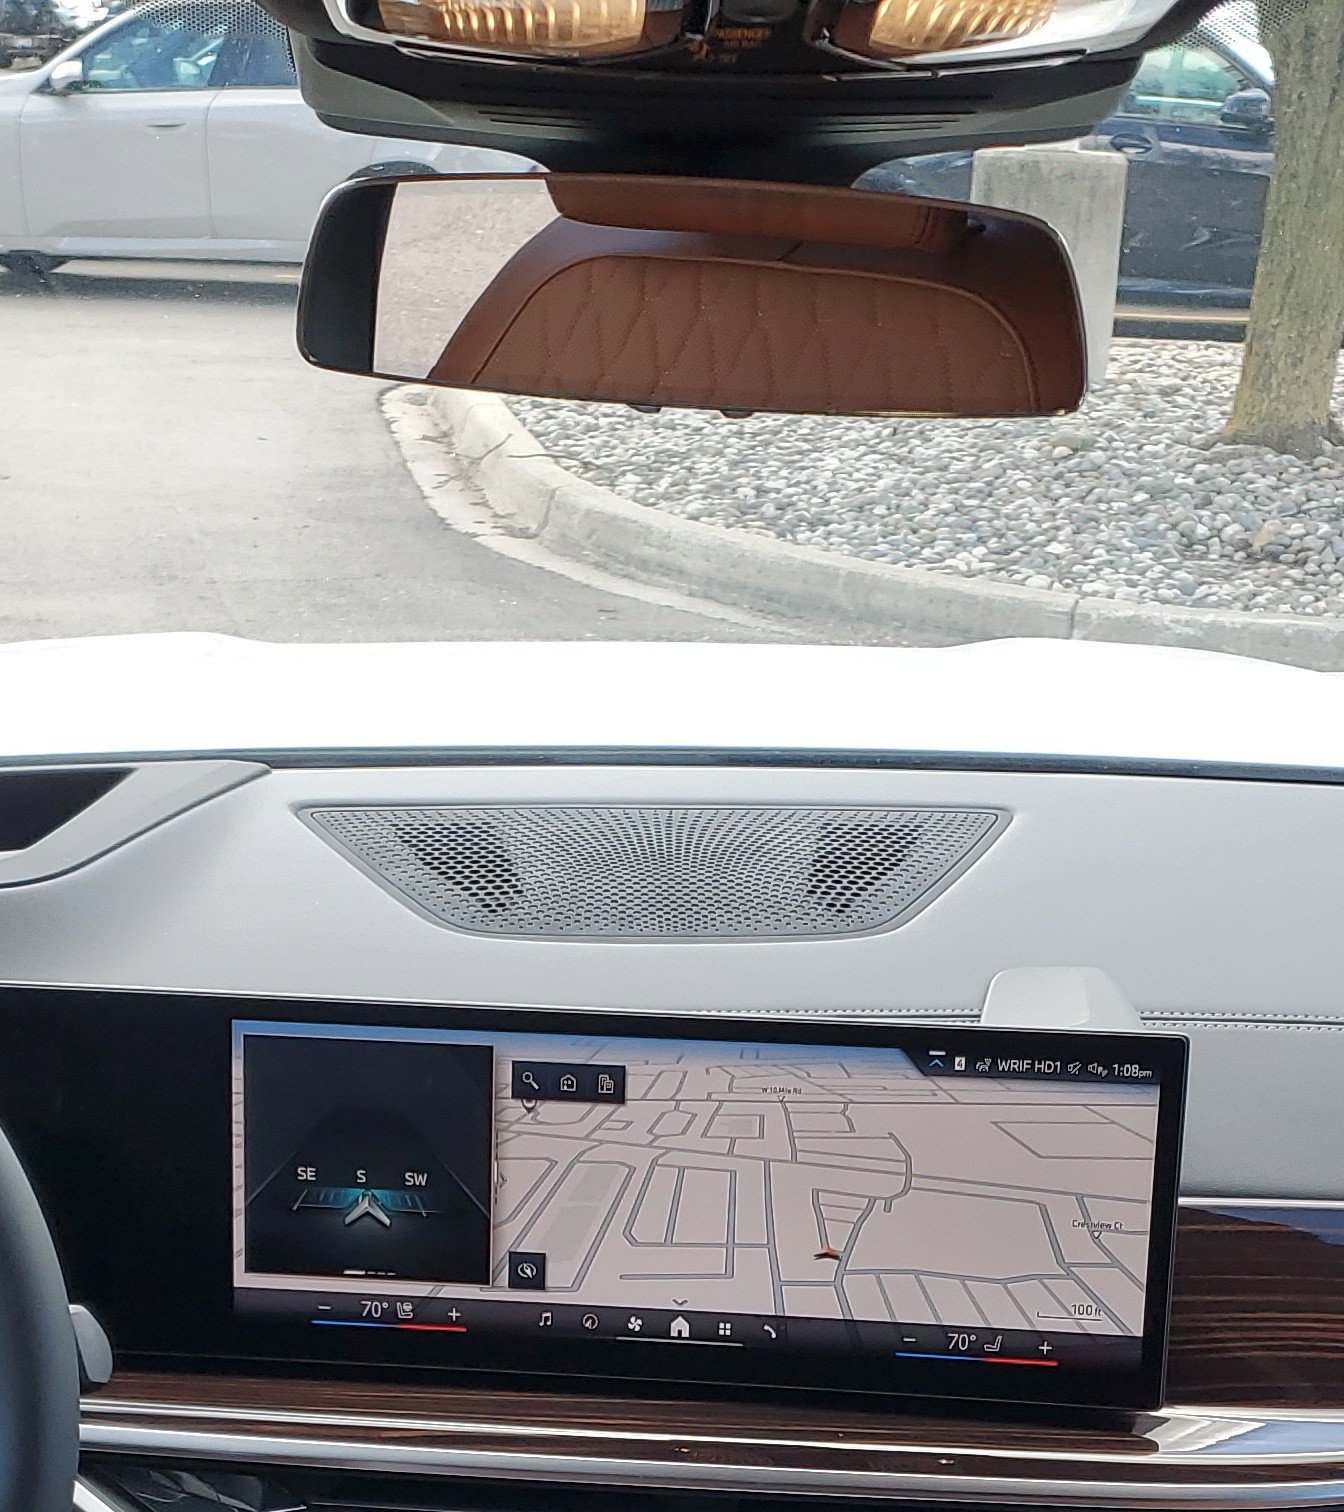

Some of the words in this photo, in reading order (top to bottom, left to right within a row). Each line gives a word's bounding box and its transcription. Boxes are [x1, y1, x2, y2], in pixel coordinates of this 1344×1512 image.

[997, 1058, 1031, 1073] WRIF
[1035, 1061, 1061, 1074] HD1
[1112, 1063, 1153, 1078] 1:08pm
[297, 1167, 317, 1181] SE
[356, 1170, 367, 1183] S
[404, 1172, 428, 1186] SW
[1071, 1304, 1093, 1316] 100
[1094, 1306, 1101, 1317] ft
